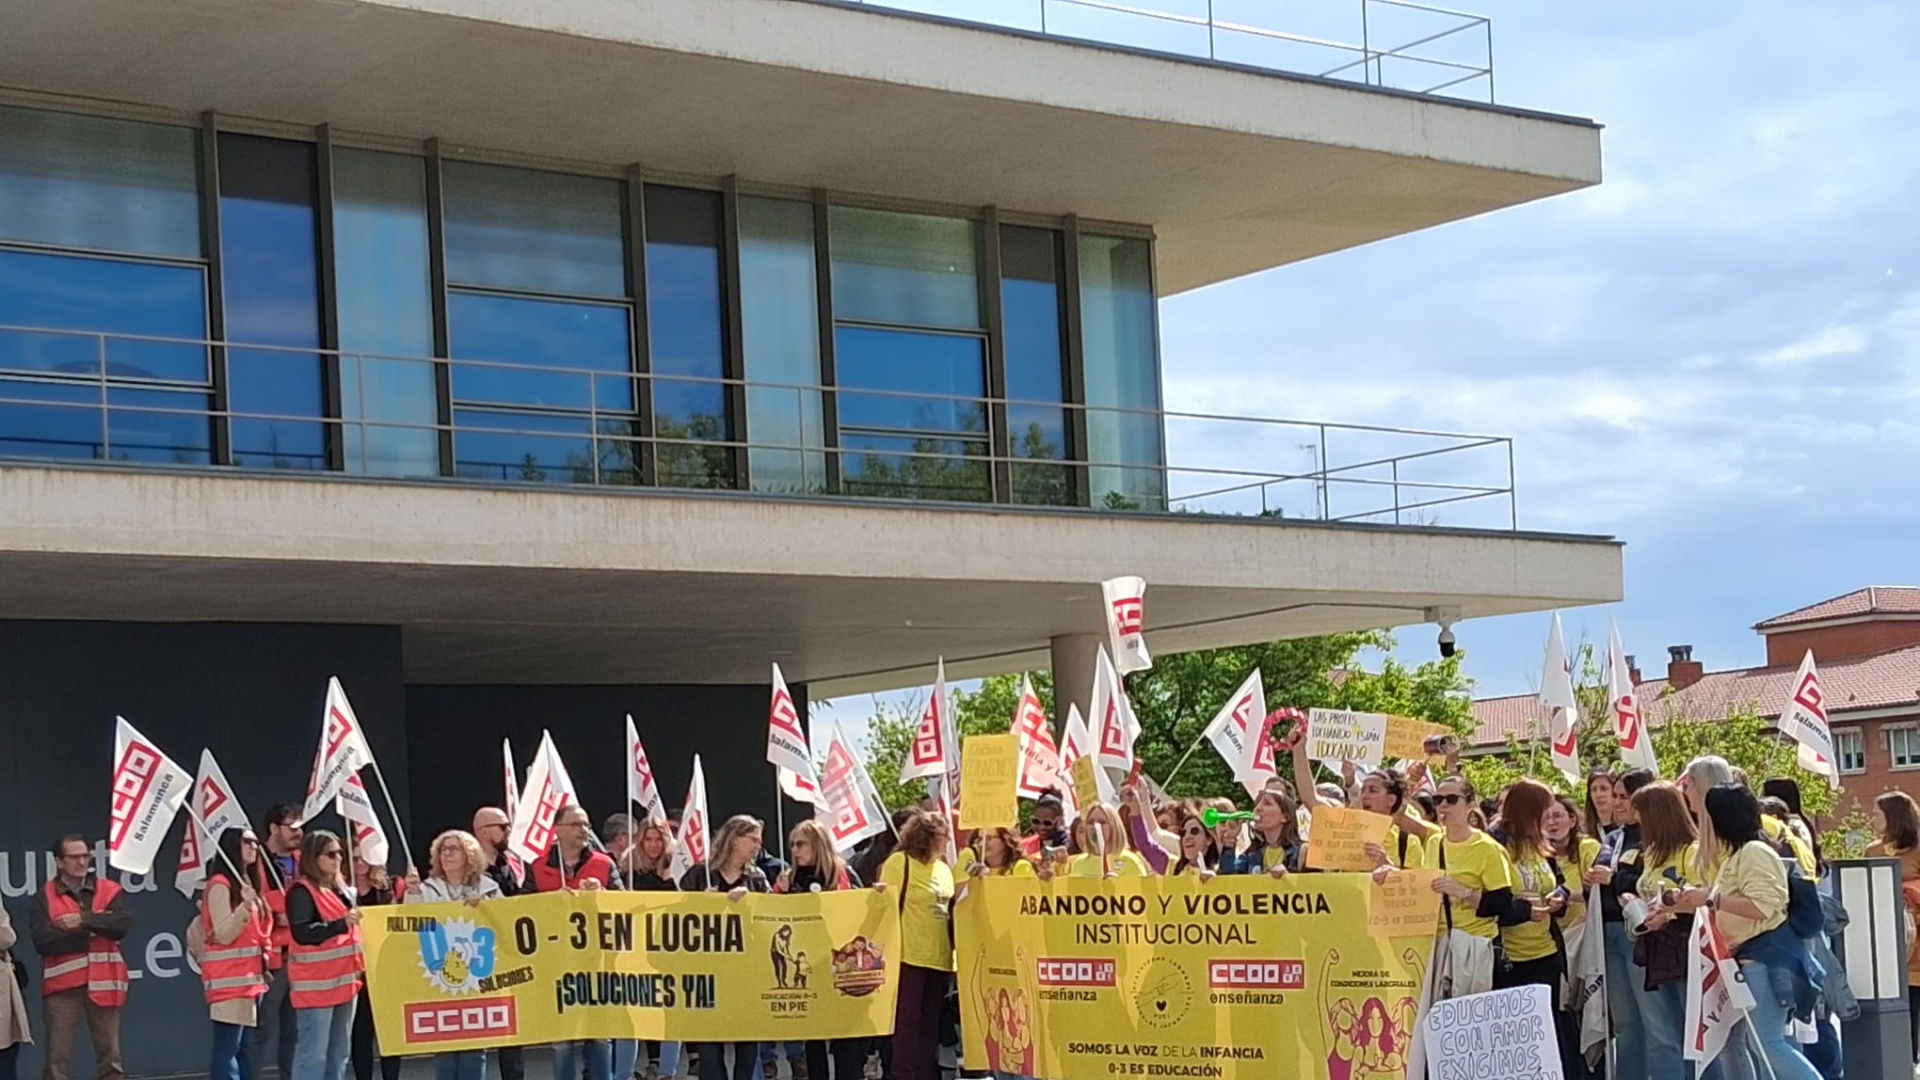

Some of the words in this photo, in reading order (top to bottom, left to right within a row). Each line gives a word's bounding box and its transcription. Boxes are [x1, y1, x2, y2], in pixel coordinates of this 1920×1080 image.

[134, 772, 174, 842] Salamanca
[1020, 895, 1146, 916] ABANDONO
[1158, 894, 1173, 916] Y
[1184, 892, 1331, 916] VIOLENCIA
[387, 916, 437, 933] MALTRATO
[569, 912, 588, 950] 3
[598, 912, 633, 951] EN
[645, 913, 745, 953] LUCHA
[1075, 923, 1258, 945] INSTITUCIONAL
[478, 965, 535, 995] SOLUCIONES
[1038, 962, 1093, 981] CCOO
[1211, 963, 1280, 984] CCOO
[1380, 970, 1391, 978] DE
[556, 971, 677, 1014] ¡SOLUCIONES
[682, 973, 716, 1009] YA!
[1039, 988, 1098, 1002] enseñanza
[1209, 990, 1284, 1005] enseñanza
[770, 1001, 787, 1012] EN
[789, 1001, 809, 1012] PIE
[1429, 986, 1537, 1032] EDUCAMOS
[412, 1005, 510, 1034] CCOO
[1440, 1025, 1484, 1057] CON
[1489, 1014, 1546, 1049] AMOR
[1068, 1042, 1112, 1055] SOMOS
[1115, 1043, 1131, 1055] LA
[1133, 1044, 1158, 1057] VOZ
[1162, 1045, 1178, 1058] DE
[1181, 1045, 1198, 1058] LA
[1200, 1046, 1265, 1060] INFANCIA
[1108, 1062, 1127, 1074] 0-3
[1129, 1063, 1145, 1075] ES
[1147, 1063, 1223, 1078] EDUCACIÓN
